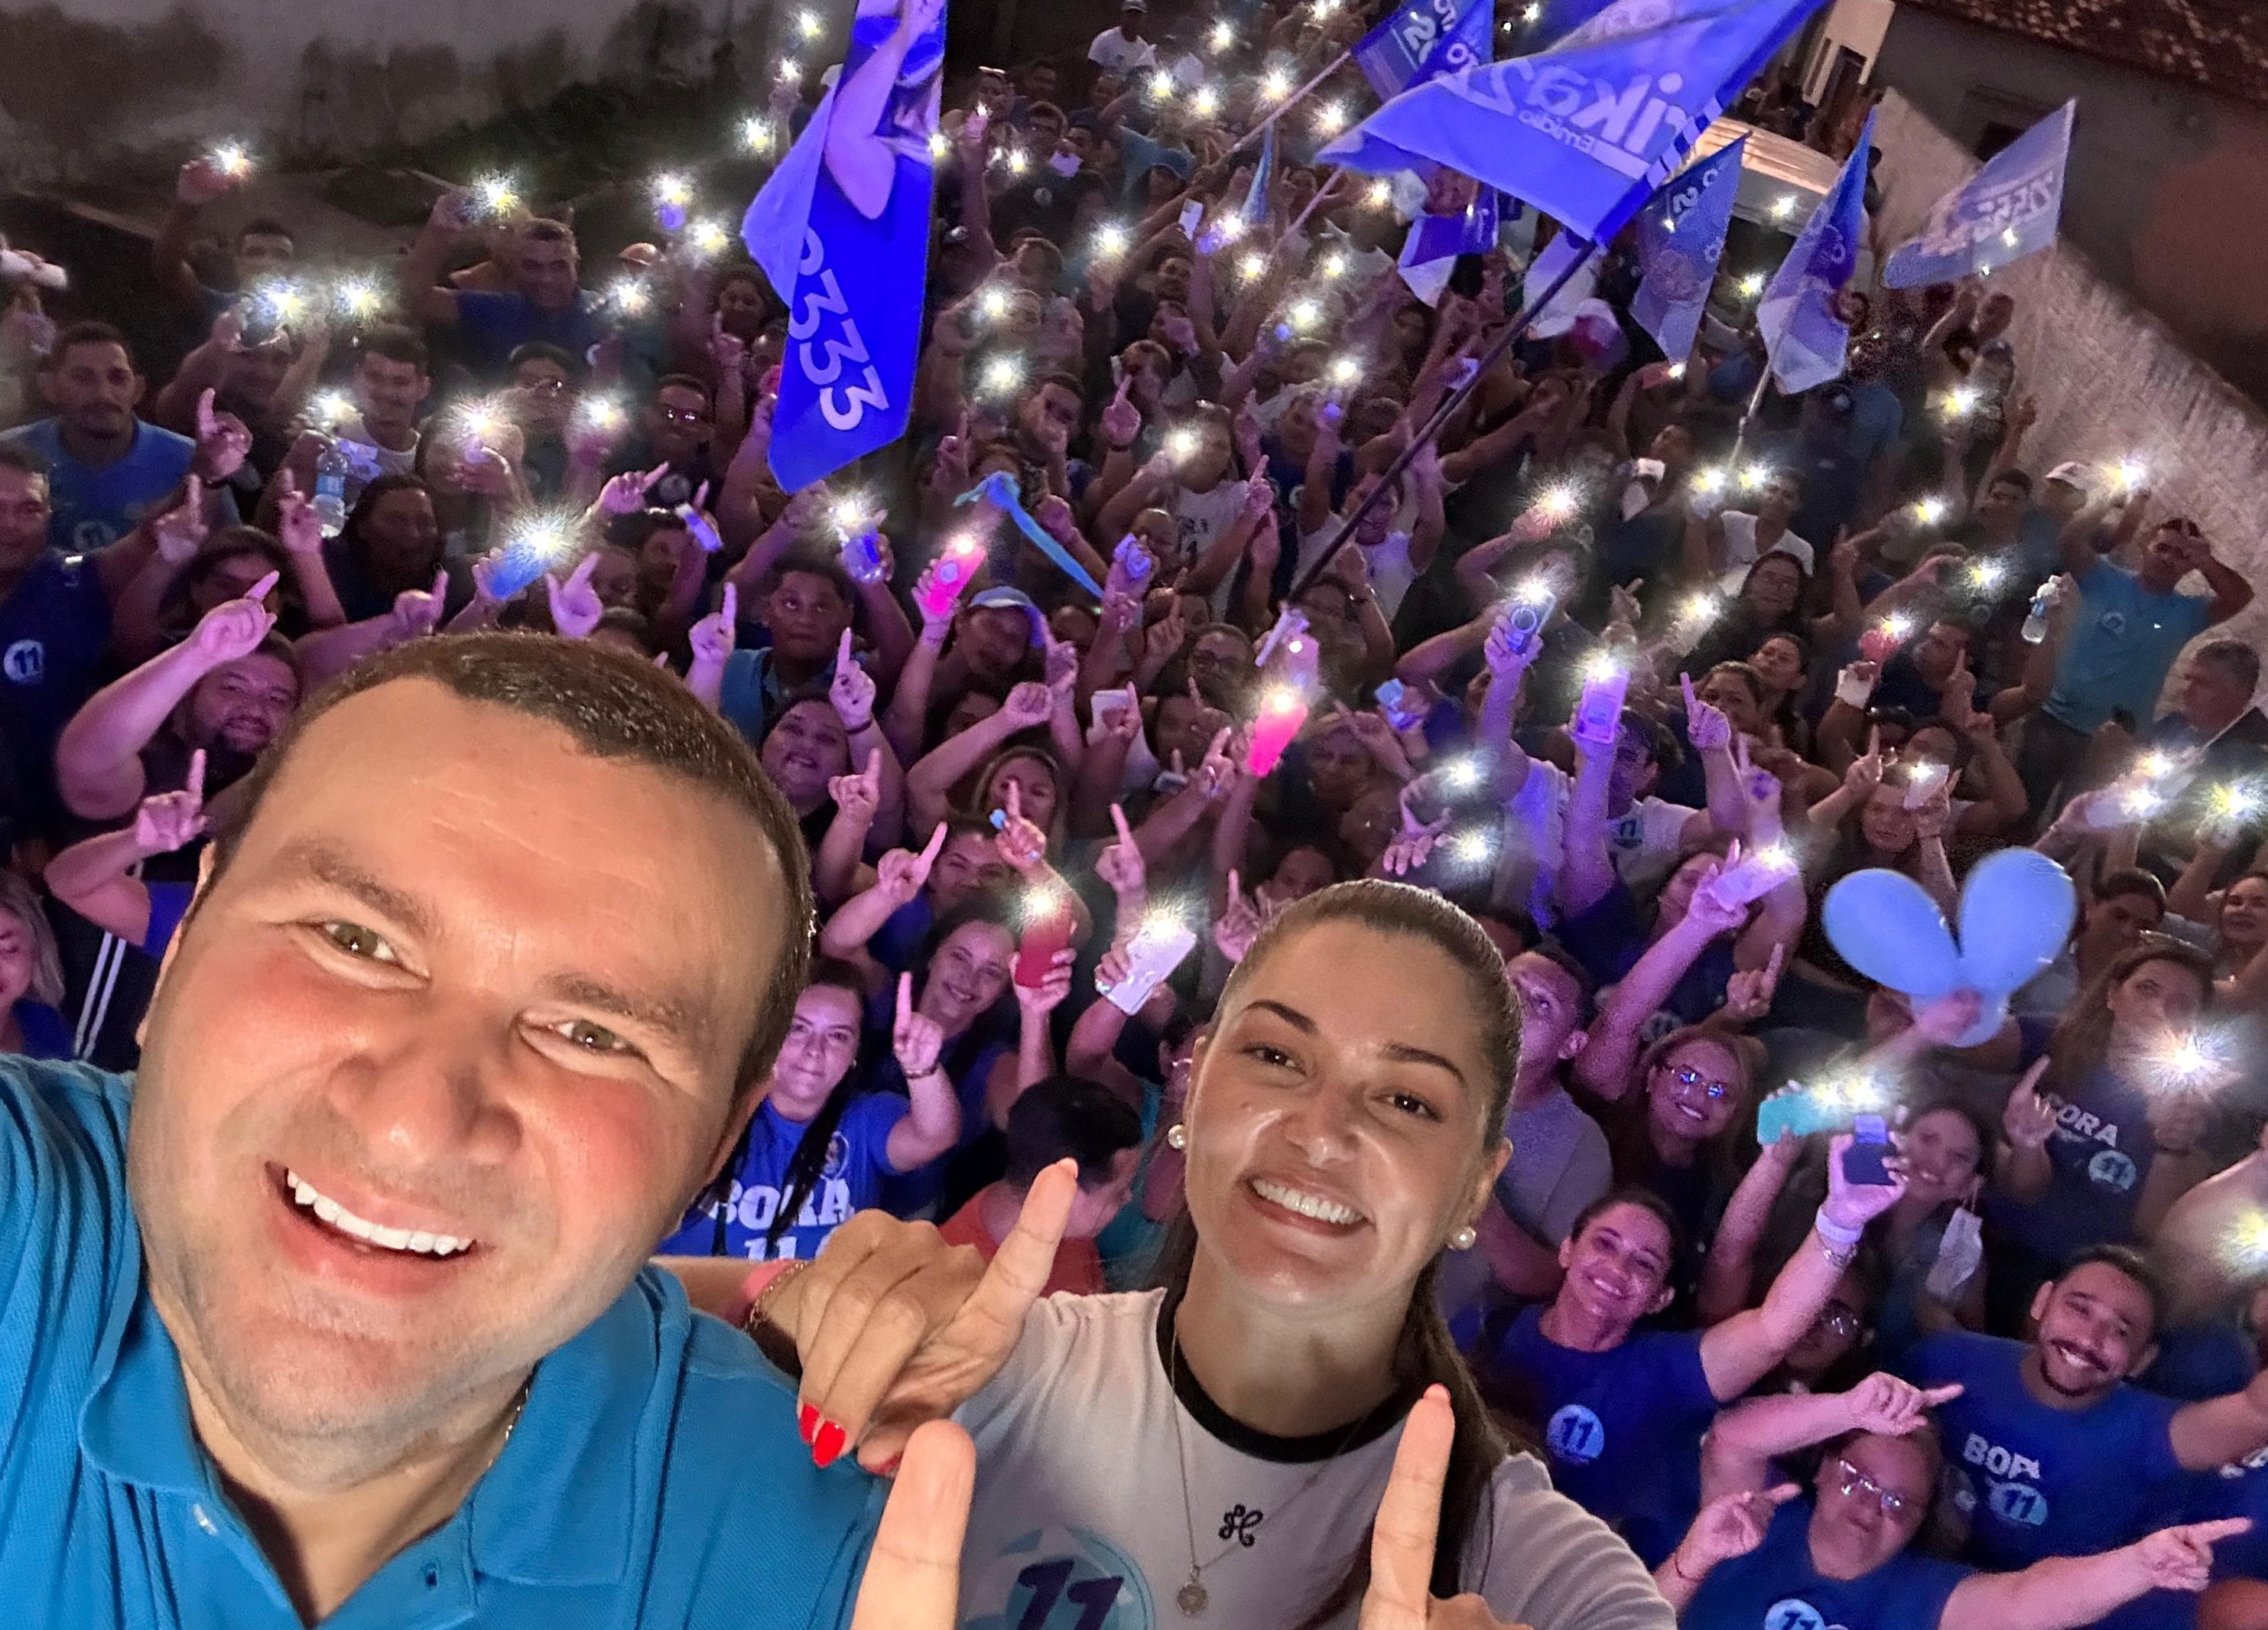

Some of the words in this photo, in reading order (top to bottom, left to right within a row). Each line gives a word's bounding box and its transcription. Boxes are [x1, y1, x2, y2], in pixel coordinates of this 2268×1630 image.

[14, 647, 39, 675] 11
[1561, 1415, 1594, 1452] 11
[2003, 1488, 2037, 1519] 11
